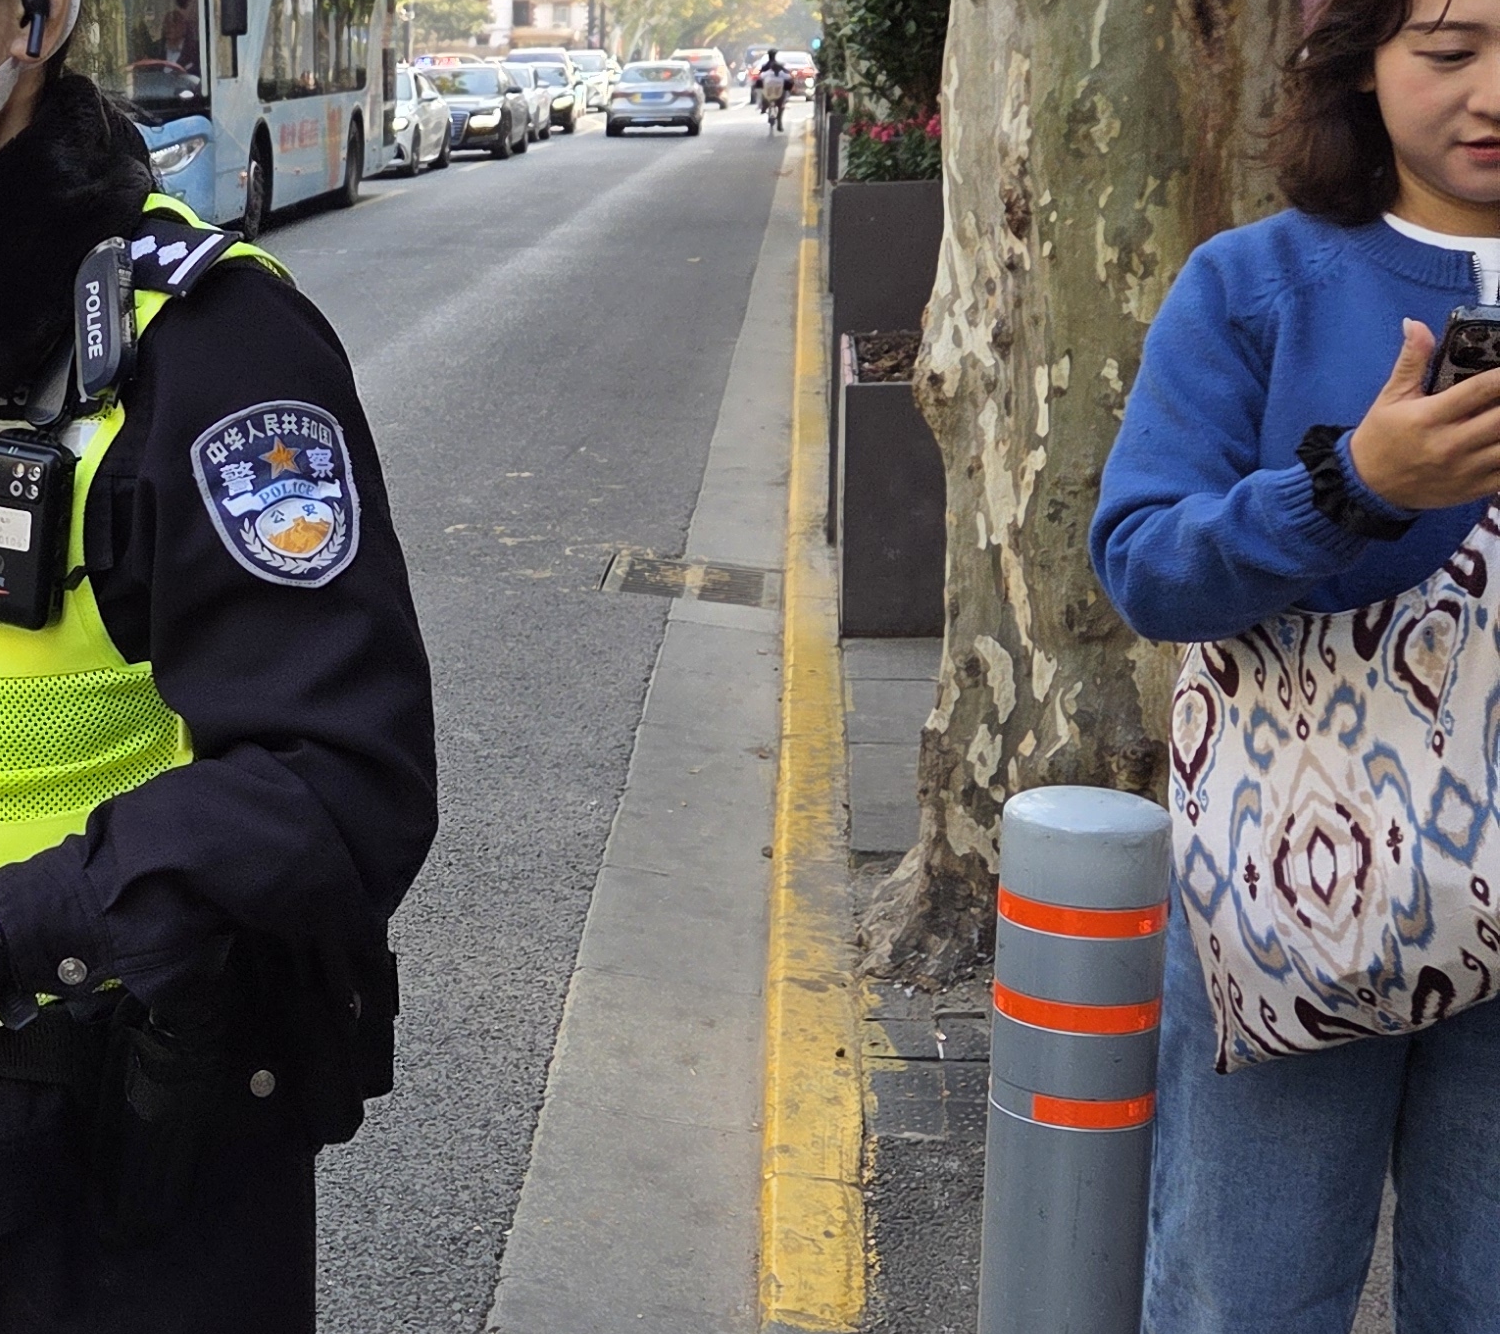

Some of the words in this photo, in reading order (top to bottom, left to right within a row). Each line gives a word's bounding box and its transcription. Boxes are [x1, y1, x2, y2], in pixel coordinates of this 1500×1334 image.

[85, 280, 104, 360] POLICE
[206, 412, 333, 465] 中华人民共和国
[258, 481, 316, 505] POLICE
